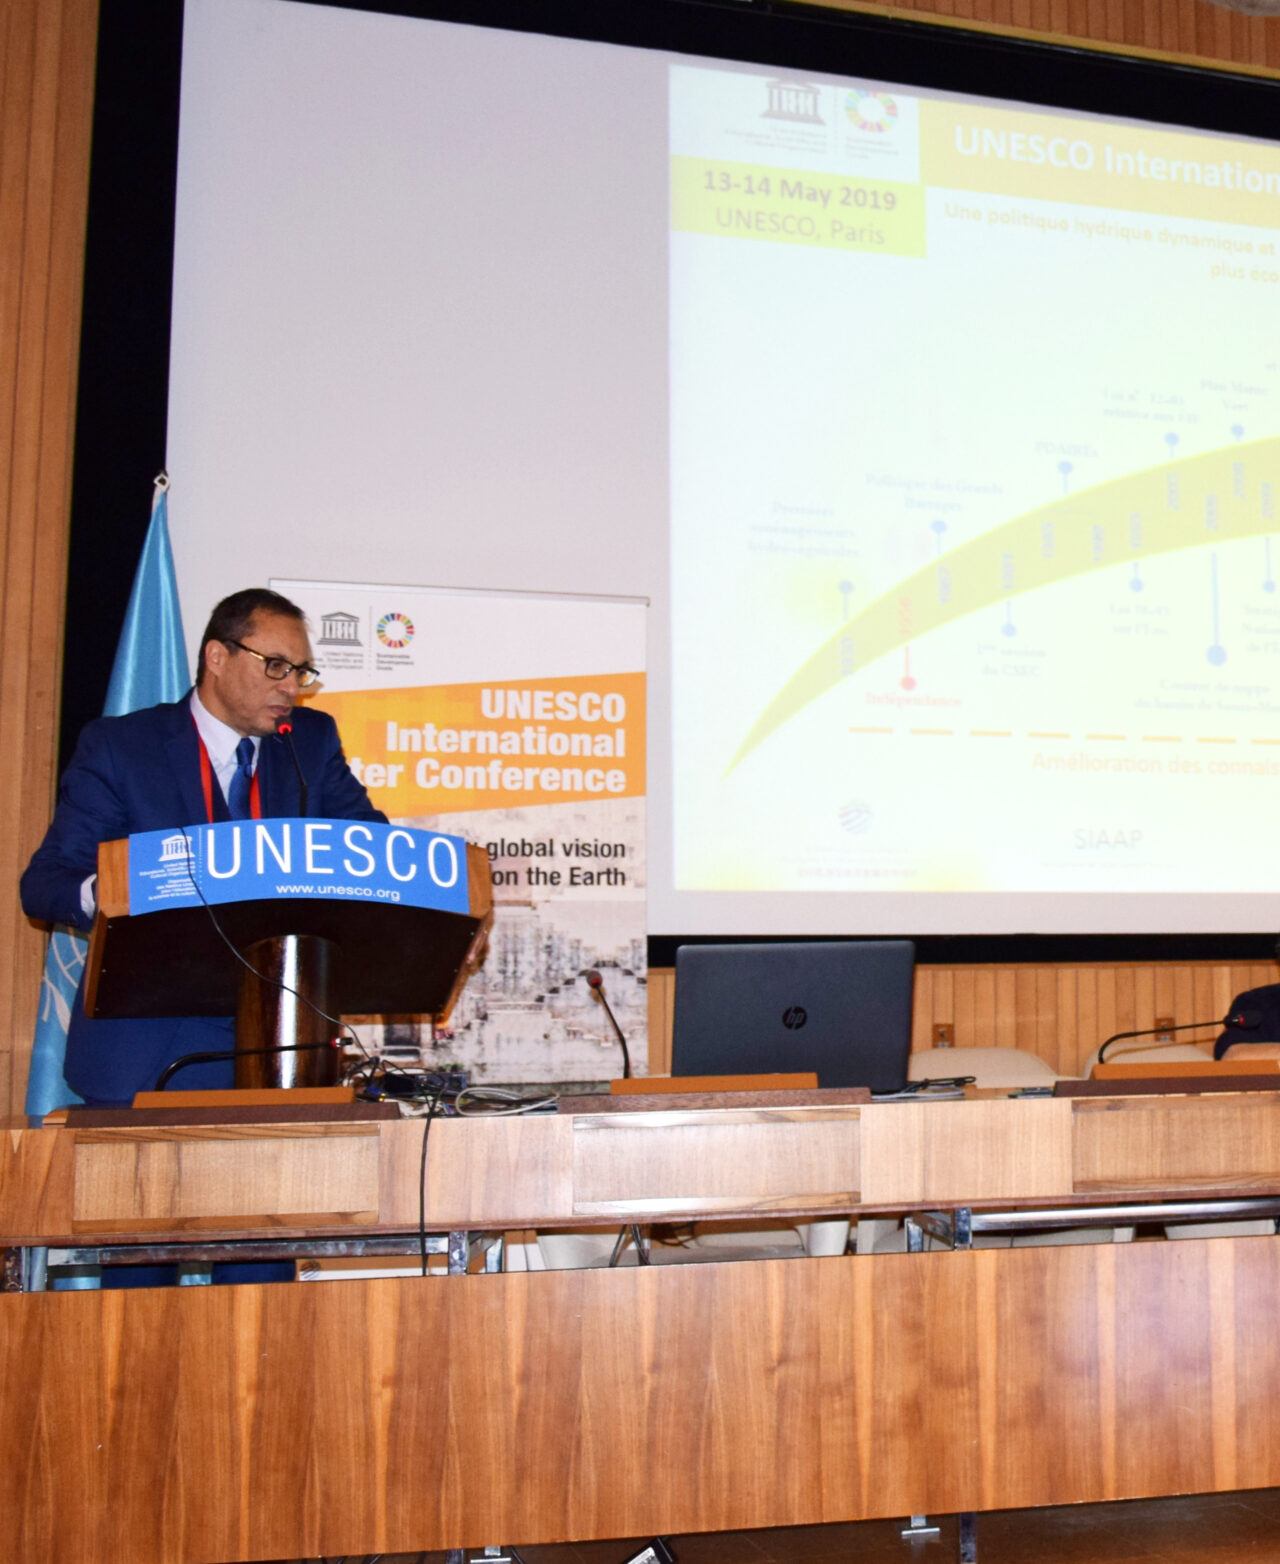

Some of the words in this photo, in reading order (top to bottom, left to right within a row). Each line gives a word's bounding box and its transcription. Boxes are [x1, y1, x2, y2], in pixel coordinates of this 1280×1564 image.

[954, 124, 1095, 171] UNESCO
[703, 169, 772, 197] 13-14
[779, 178, 834, 208] May
[839, 185, 898, 211] 2019
[715, 206, 823, 241] UNESCO,
[829, 219, 886, 246] Paris
[944, 201, 983, 223] Une
[987, 206, 1069, 236] politique
[1073, 216, 1153, 244] hydrique
[1157, 225, 1255, 259] dynamique
[1259, 241, 1277, 258] et
[1209, 260, 1247, 284] plus
[480, 688, 627, 723] UNESCO
[386, 721, 627, 758] International
[349, 757, 404, 788] ter
[415, 758, 627, 793] Conference
[1032, 750, 1163, 775] Amélioration
[1168, 756, 1202, 775] des
[206, 823, 460, 889] UNESCO
[486, 837, 555, 861] global
[561, 838, 626, 859] vision
[1073, 827, 1144, 850] SIAAP
[275, 883, 401, 902] www.unesco.org
[491, 869, 519, 887] on
[526, 866, 561, 887] the
[569, 868, 626, 887] Earth
